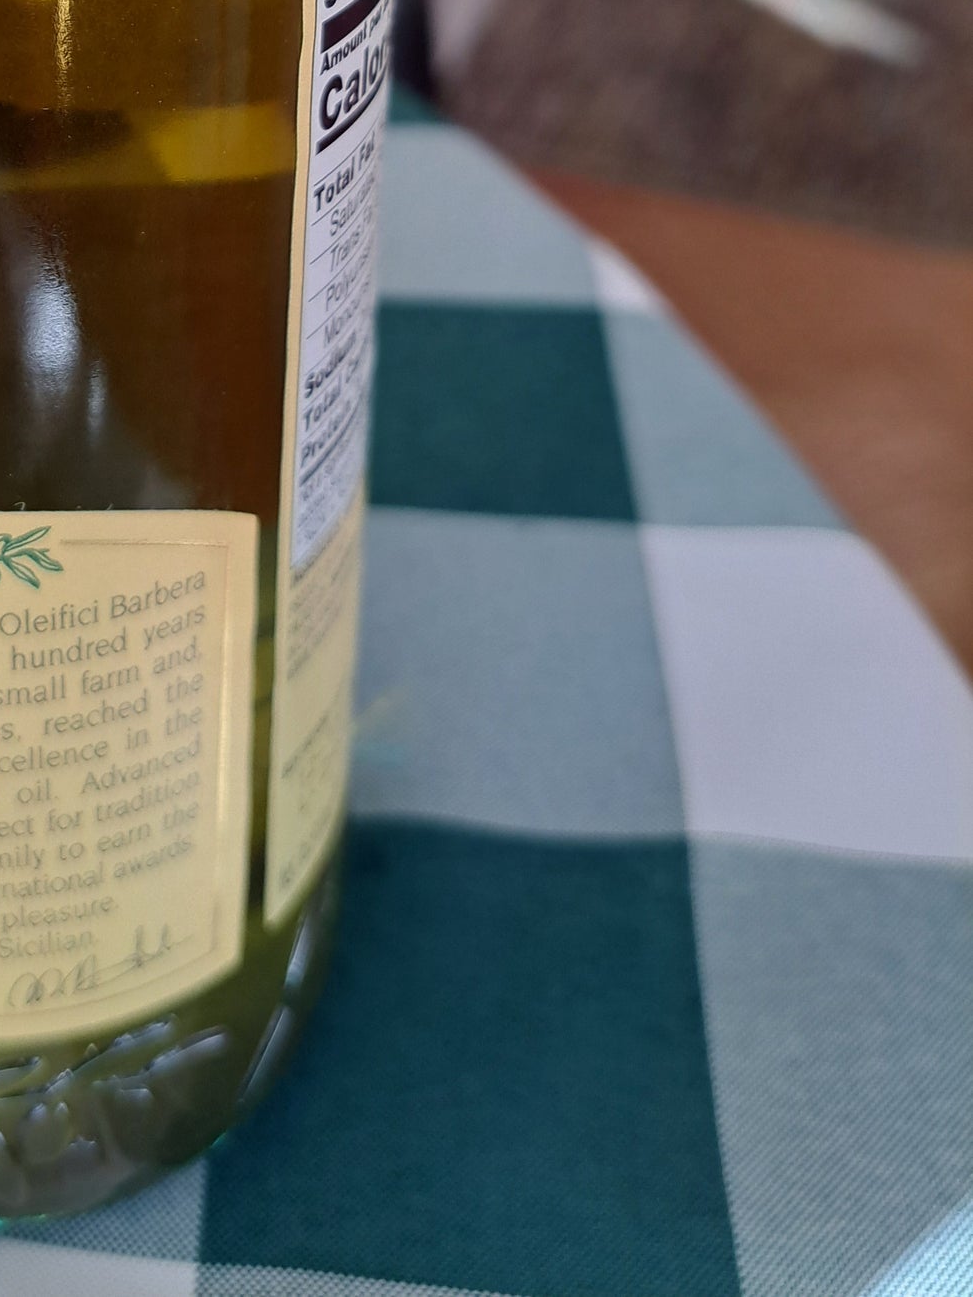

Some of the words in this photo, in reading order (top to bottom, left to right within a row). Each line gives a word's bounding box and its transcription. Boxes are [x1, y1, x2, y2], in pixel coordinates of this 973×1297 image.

[320, 21, 367, 76] Amount
[314, 156, 355, 212] Total
[0, 600, 99, 636] Oleifici
[110, 571, 206, 619] Barbera
[11, 627, 127, 671] hundred
[144, 605, 205, 650] years
[44, 688, 148, 736] reached
[166, 672, 204, 703] the
[81, 664, 140, 694] farm
[127, 727, 150, 751] in
[165, 705, 203, 736] the
[81, 732, 201, 793] Advanced
[47, 808, 84, 832] for
[95, 771, 200, 822] tradition
[58, 843, 85, 862] to
[97, 822, 151, 852] earn
[162, 802, 199, 832] the
